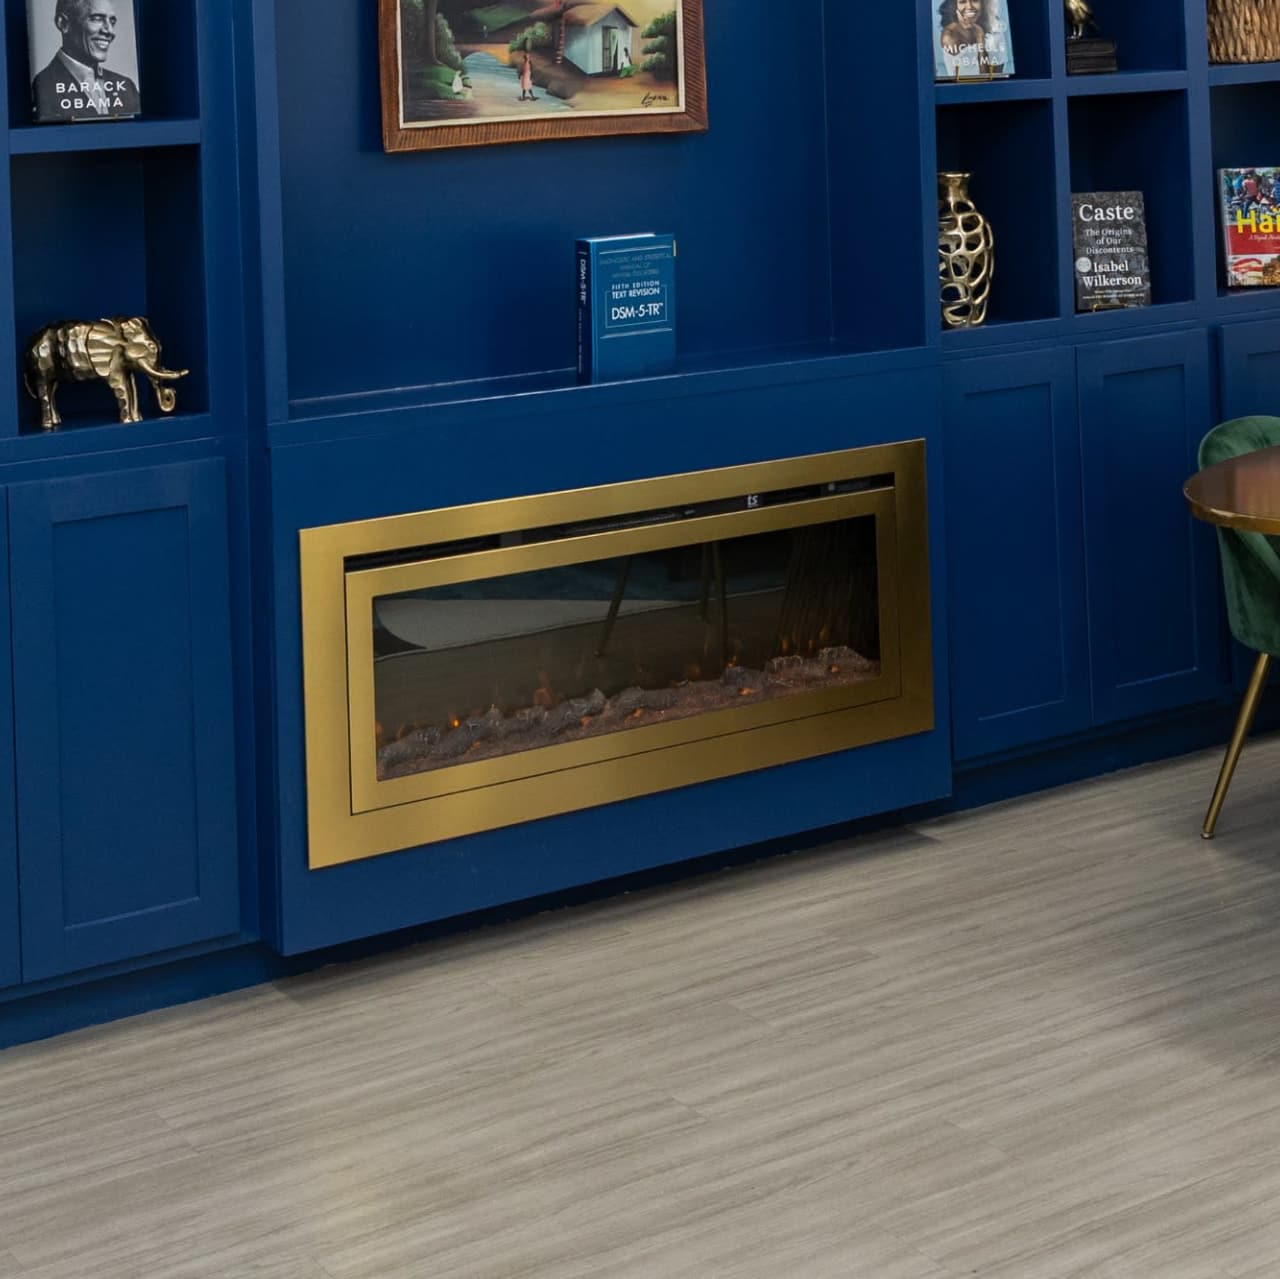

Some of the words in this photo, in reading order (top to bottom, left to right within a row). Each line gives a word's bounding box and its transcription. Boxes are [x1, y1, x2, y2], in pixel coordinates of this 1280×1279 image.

[55, 80, 127, 93] BARACK
[60, 97, 124, 109] OBAMA
[1079, 203, 1134, 222] Caste
[1086, 228, 1100, 237] The
[1102, 227, 1133, 237] Origins
[1095, 236, 1105, 245] of
[1106, 237, 1122, 245] Our
[1086, 246, 1134, 255] Discontents
[1093, 260, 1129, 273] Isabel
[612, 283, 629, 291] FIFTH
[632, 280, 660, 289] EDITION
[1082, 274, 1142, 290] Wilkerson
[612, 290, 627, 299] TEXT
[628, 287, 660, 297] REVISION
